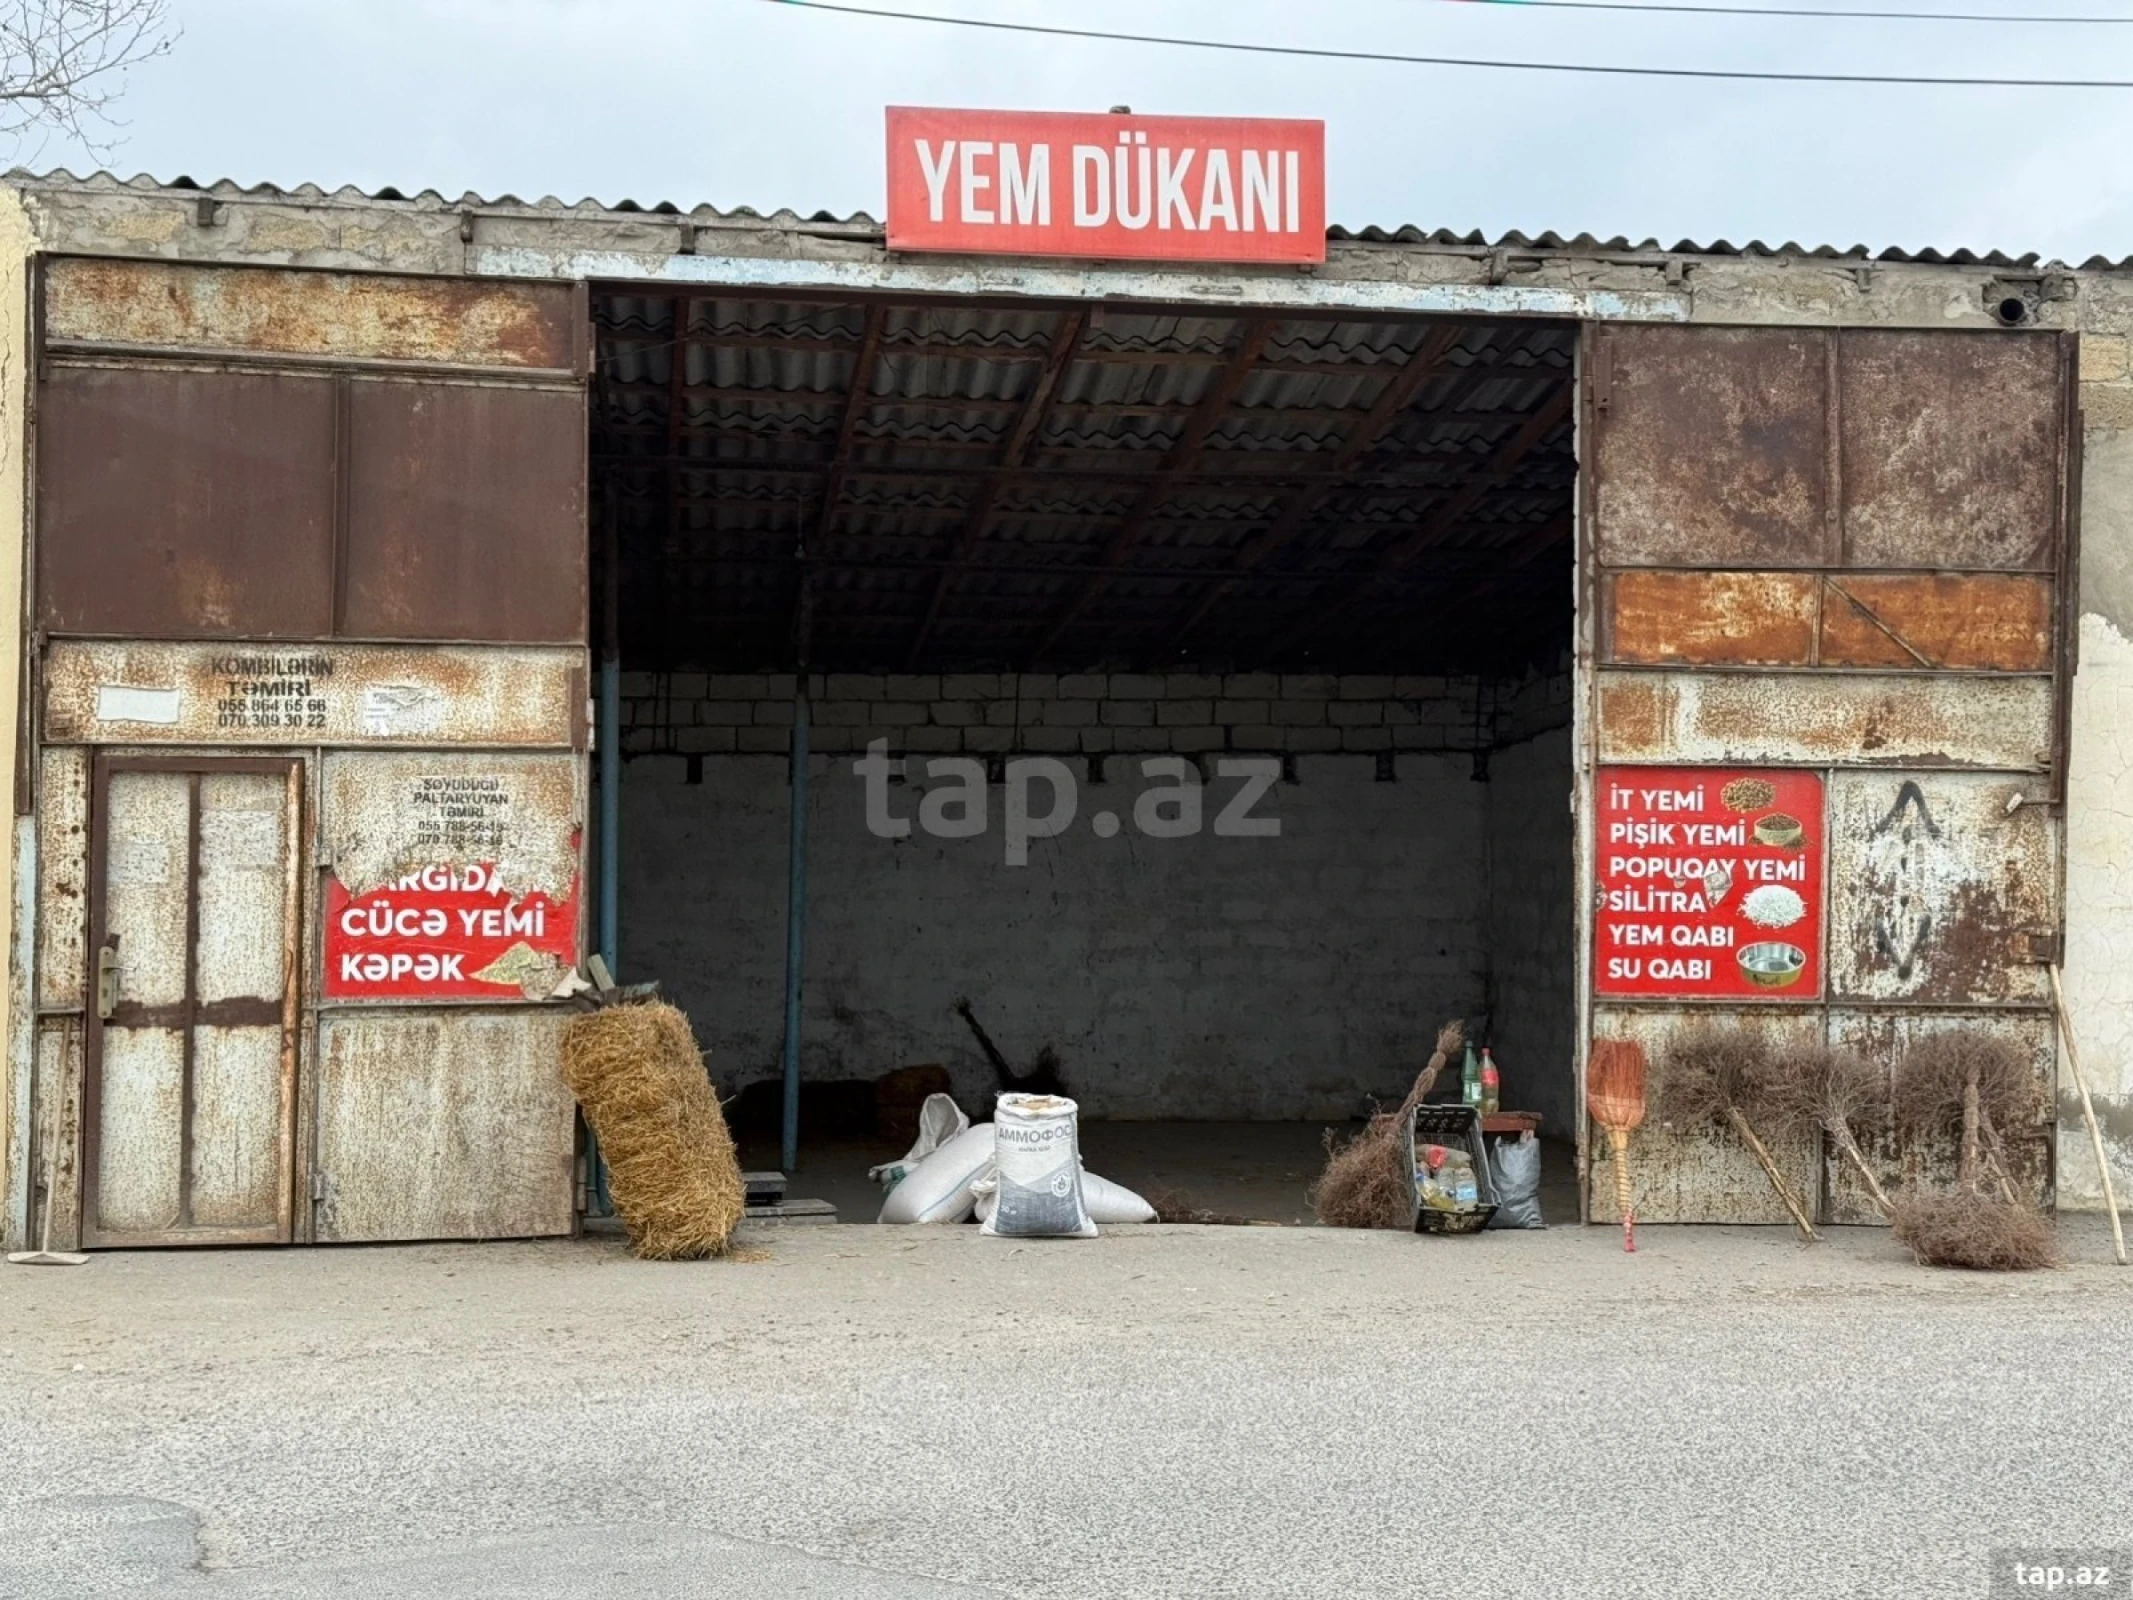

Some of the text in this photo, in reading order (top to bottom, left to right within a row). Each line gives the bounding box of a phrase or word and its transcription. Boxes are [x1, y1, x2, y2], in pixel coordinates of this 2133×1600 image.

[914, 131, 1299, 233] YEM DÜKANI
[226, 679, 311, 697] TƏMİRİ
[218, 699, 247, 712] 055
[285, 699, 304, 712] 65
[219, 714, 326, 727] 070 309 30 22
[414, 791, 509, 805] PALTARYUYAN
[1611, 783, 1704, 812] İT YEMİ
[1610, 816, 1745, 849] PİŞİK YEMİ
[1609, 854, 1806, 881] POPUQAY YEMİ
[1608, 884, 1707, 914] SİLİTRA
[341, 900, 545, 937] CÜCƏ YEMİ
[1608, 924, 1734, 948] YEM QABI
[341, 953, 465, 982] KƏPƏK
[1608, 957, 1712, 981] SU QABI
